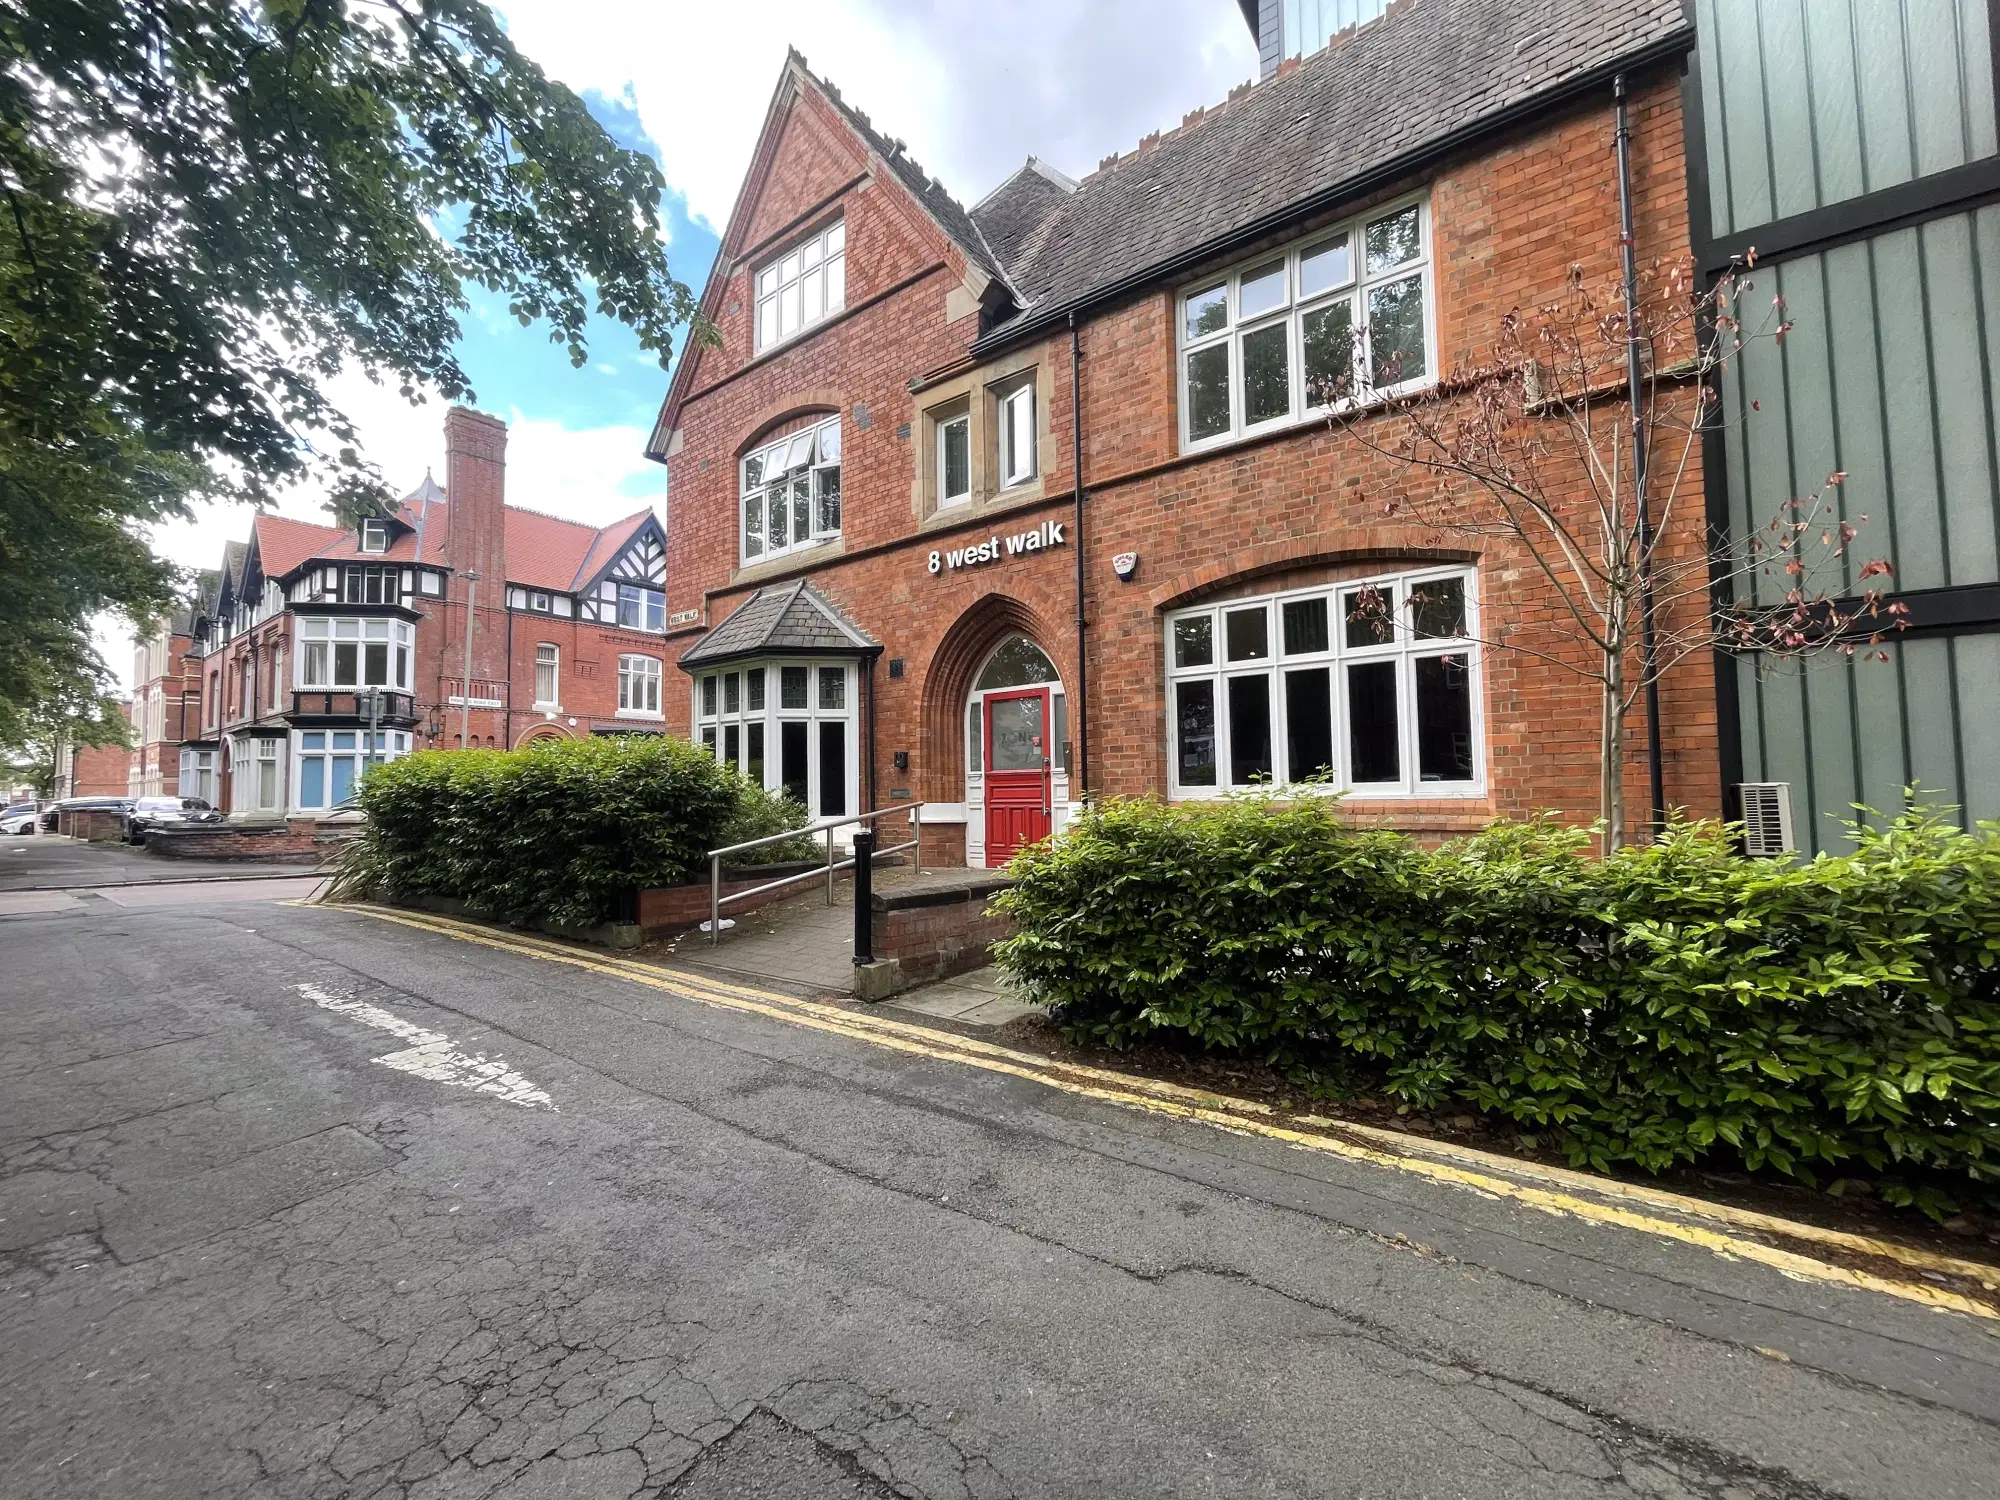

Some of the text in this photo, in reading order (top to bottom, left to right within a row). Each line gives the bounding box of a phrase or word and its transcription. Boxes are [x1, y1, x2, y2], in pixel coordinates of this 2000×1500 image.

[928, 520, 1064, 574] 8 west walk
